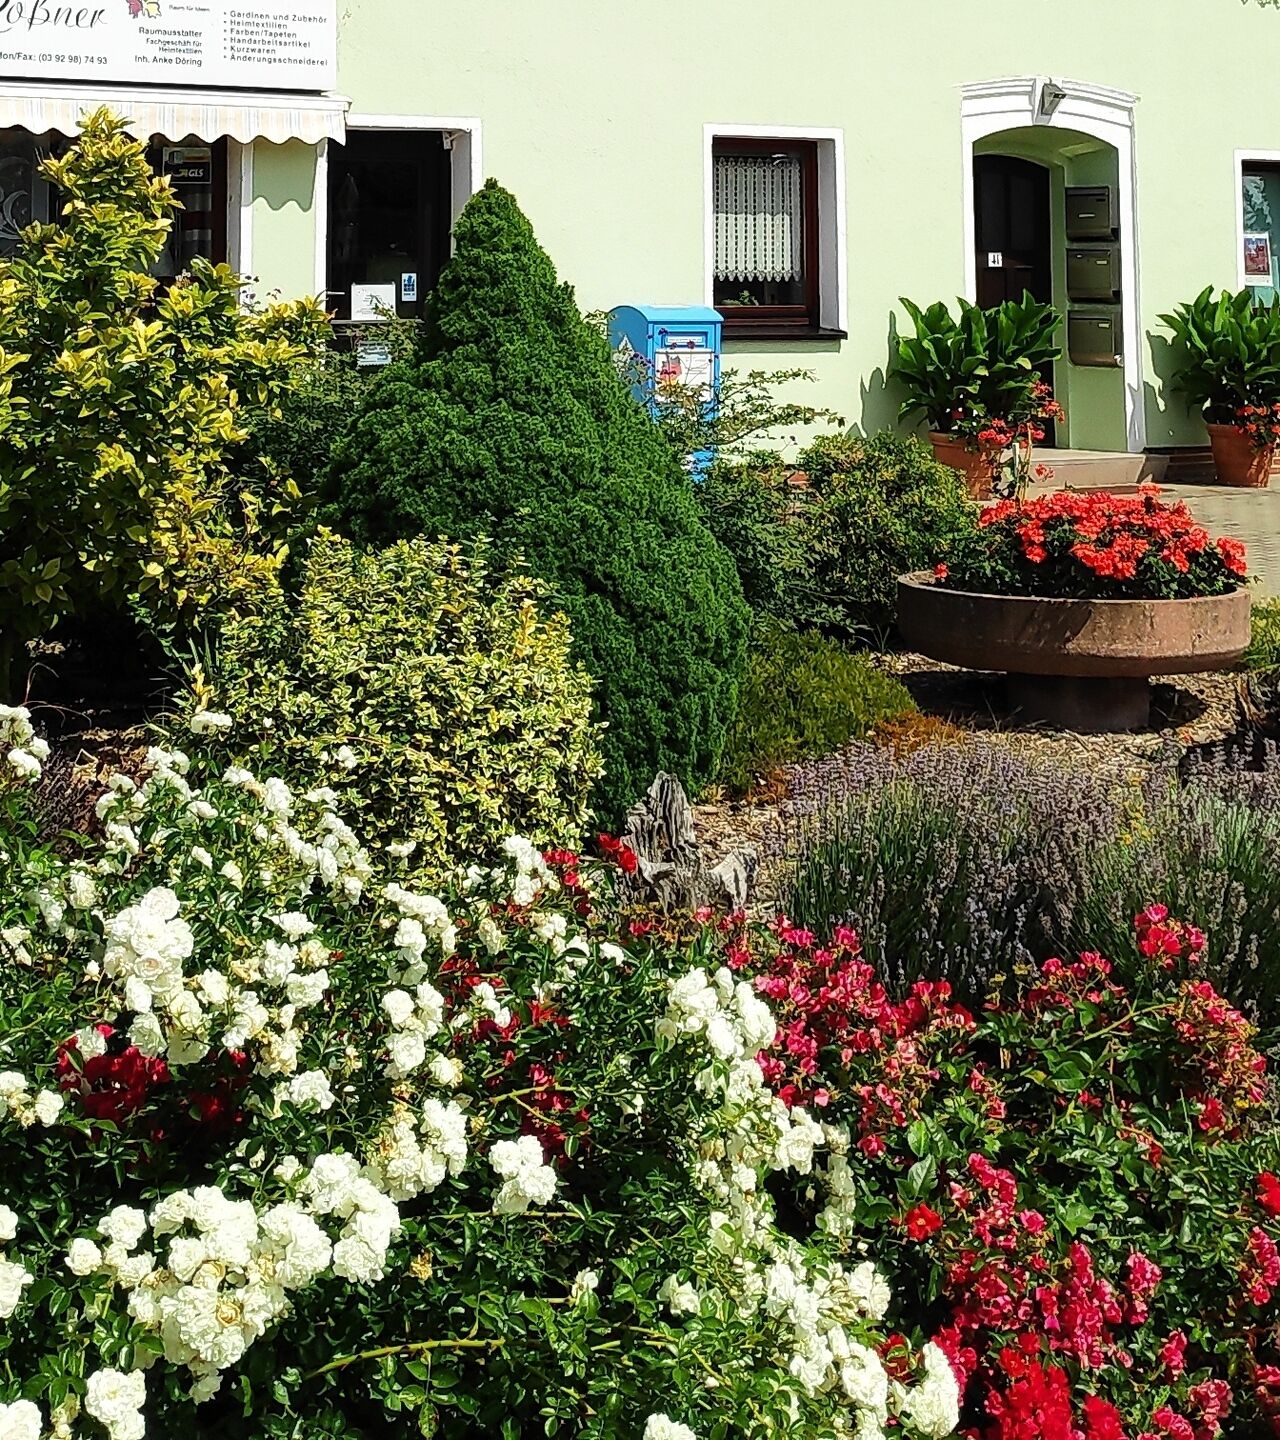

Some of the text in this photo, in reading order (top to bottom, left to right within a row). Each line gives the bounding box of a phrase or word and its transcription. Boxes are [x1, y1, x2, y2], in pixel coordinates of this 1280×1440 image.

[230, 10, 270, 20] Gardinen
[292, 14, 327, 23] Zubehör
[230, 19, 288, 29] Heimtextilien
[139, 26, 202, 37] Raumausstatter
[230, 28, 297, 39] Farben/Tapeten
[230, 37, 311, 48] Handarbeitsartikel
[230, 45, 276, 54] Kurzwaren
[38, 53, 52, 63] (03
[55, 54, 66, 63] 92
[68, 54, 82, 64] 98)
[84, 56, 94, 64] 74
[97, 56, 107, 64] 93
[135, 55, 202, 67] Inh. Anke Döring
[230, 52, 328, 66] Änderungsschneiderei
[188, 168, 204, 177] GLS
